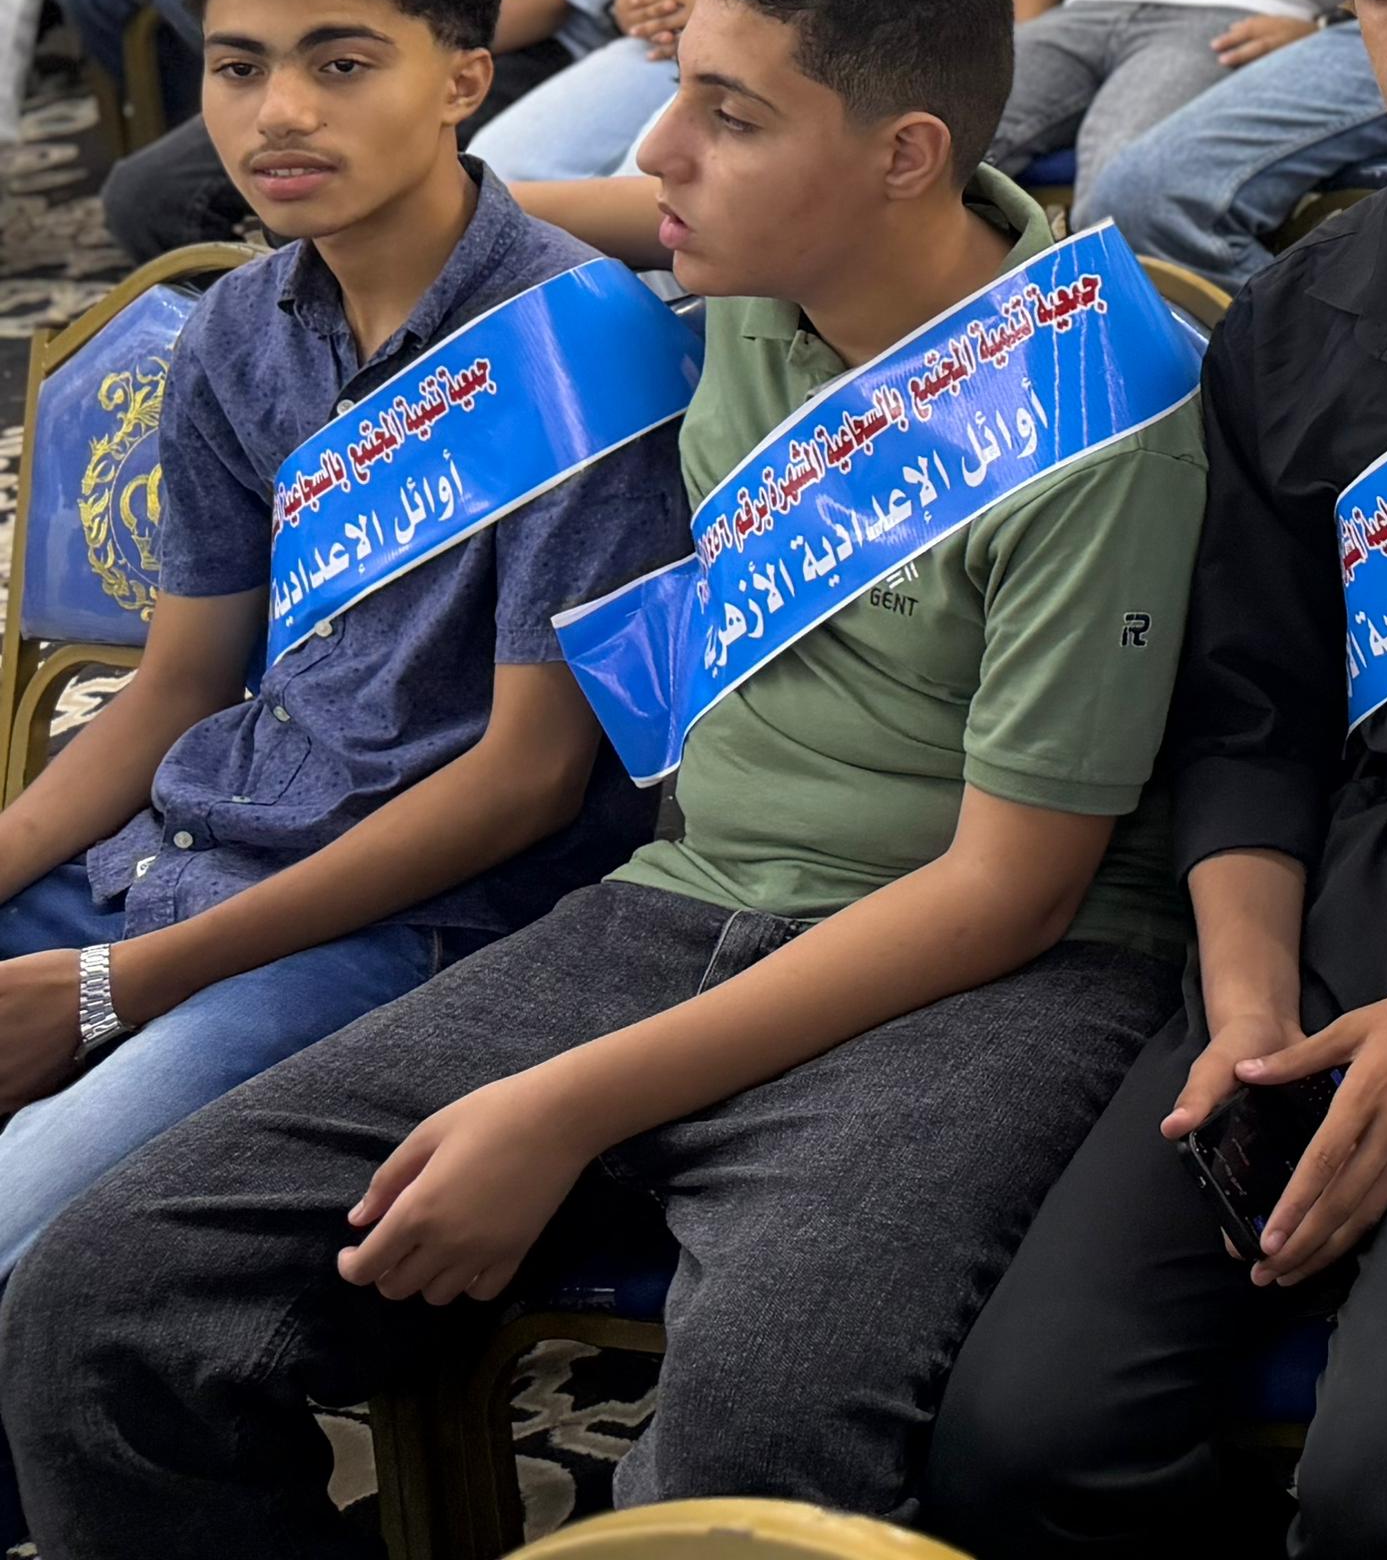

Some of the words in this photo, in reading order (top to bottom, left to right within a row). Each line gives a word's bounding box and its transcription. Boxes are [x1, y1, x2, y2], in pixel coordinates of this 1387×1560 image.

[967, 295, 1034, 368] تنمية
[1025, 274, 1107, 332] جمعية
[395, 374, 447, 439] تنمية
[440, 358, 495, 412] جمعية
[908, 335, 976, 420] المجتمع
[347, 409, 405, 484] المجتمع
[814, 384, 909, 474] بالسجاعية
[962, 378, 1048, 487] أوائل
[394, 449, 464, 544] أوائل
[791, 450, 950, 587] الإعدادية
[869, 587, 919, 617] GENT
